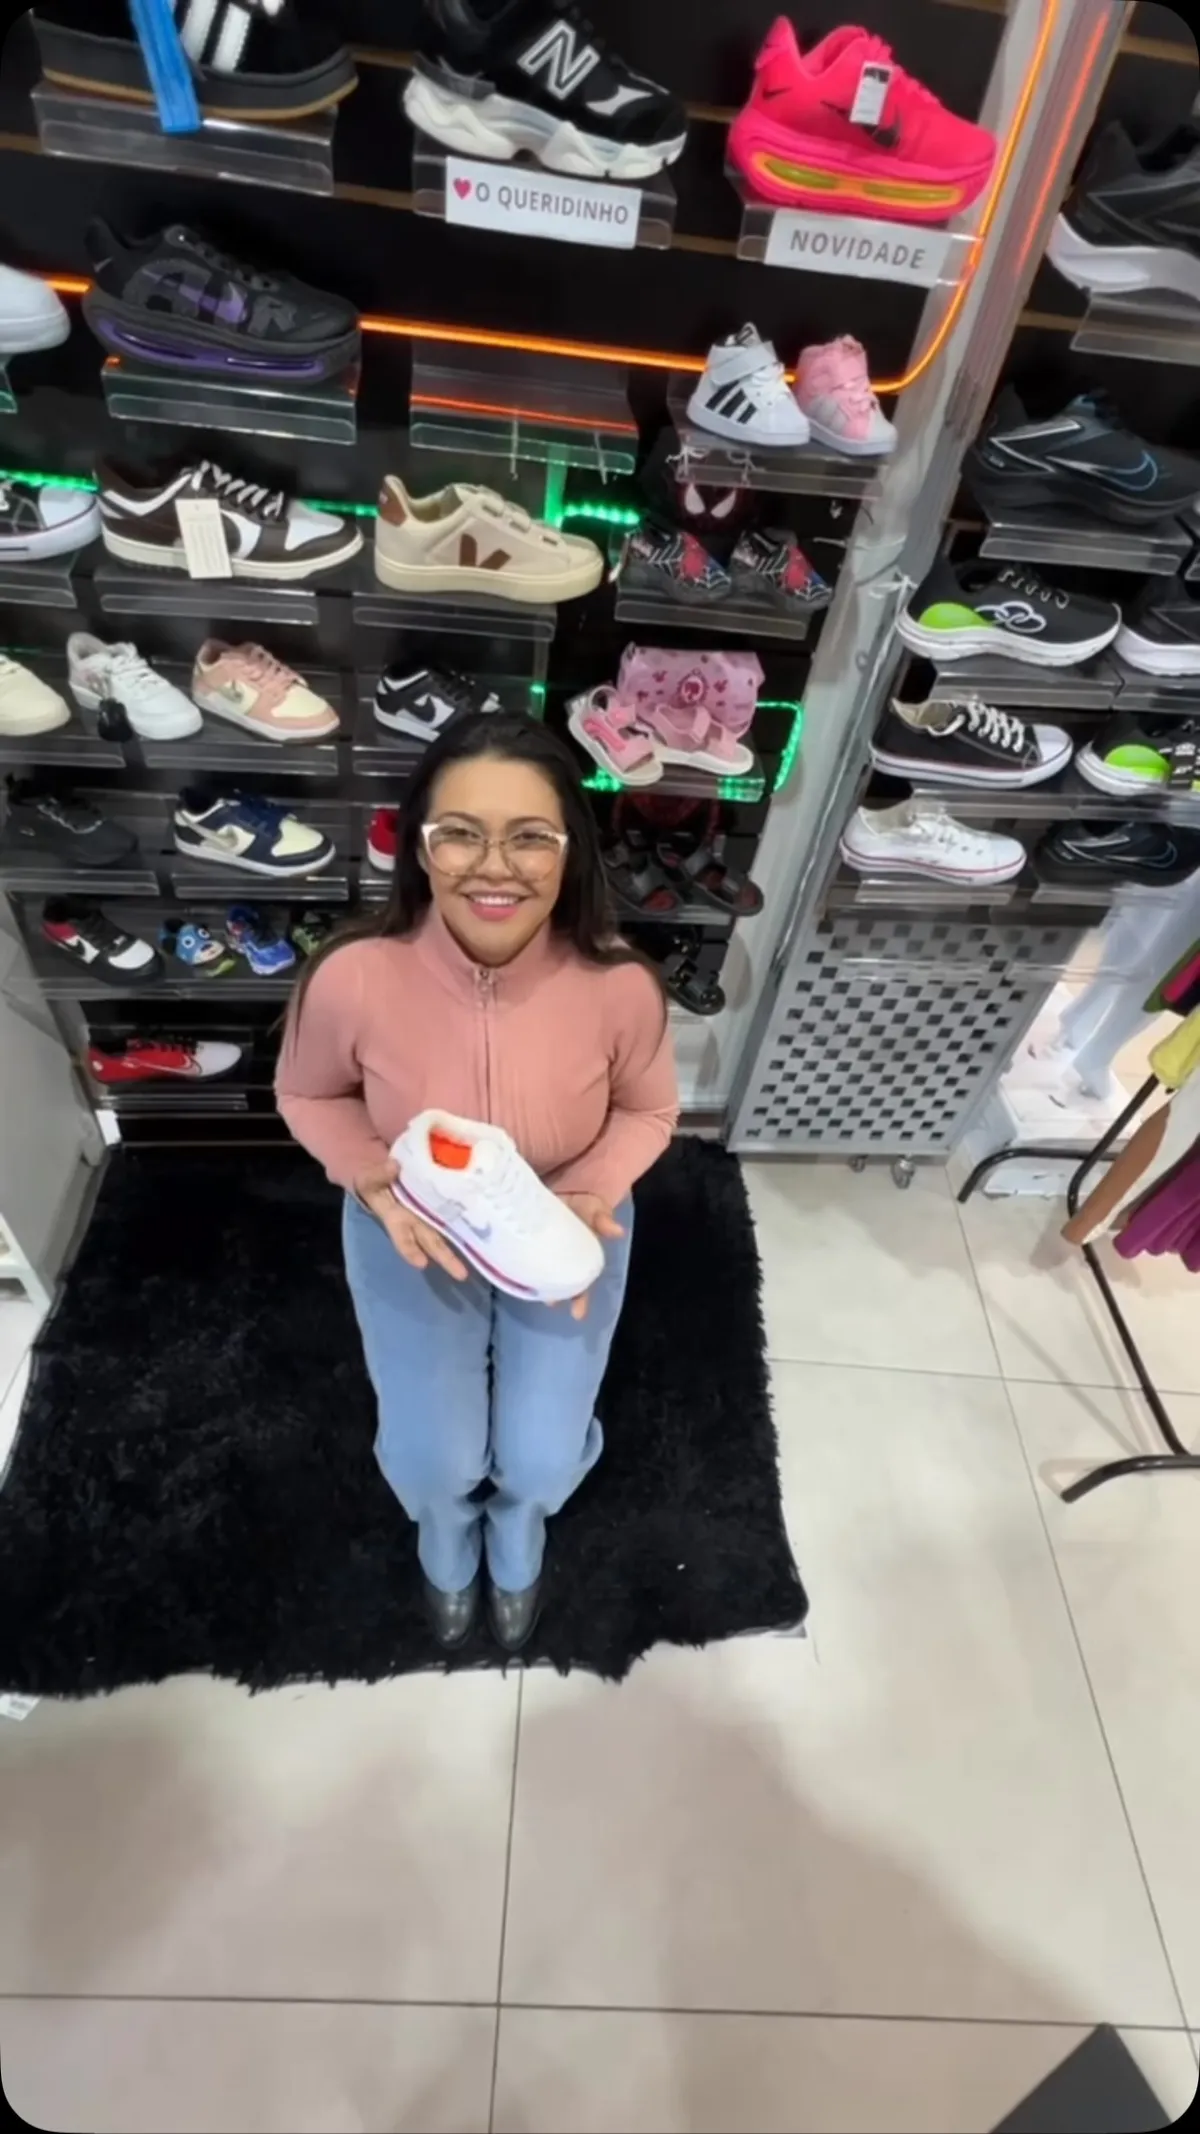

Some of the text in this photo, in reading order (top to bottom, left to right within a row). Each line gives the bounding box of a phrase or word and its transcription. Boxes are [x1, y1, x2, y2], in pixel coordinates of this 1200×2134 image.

[517, 19, 600, 100] N
[475, 182, 628, 224] O QUERIDINHO
[790, 229, 926, 269] NOVIDADE
